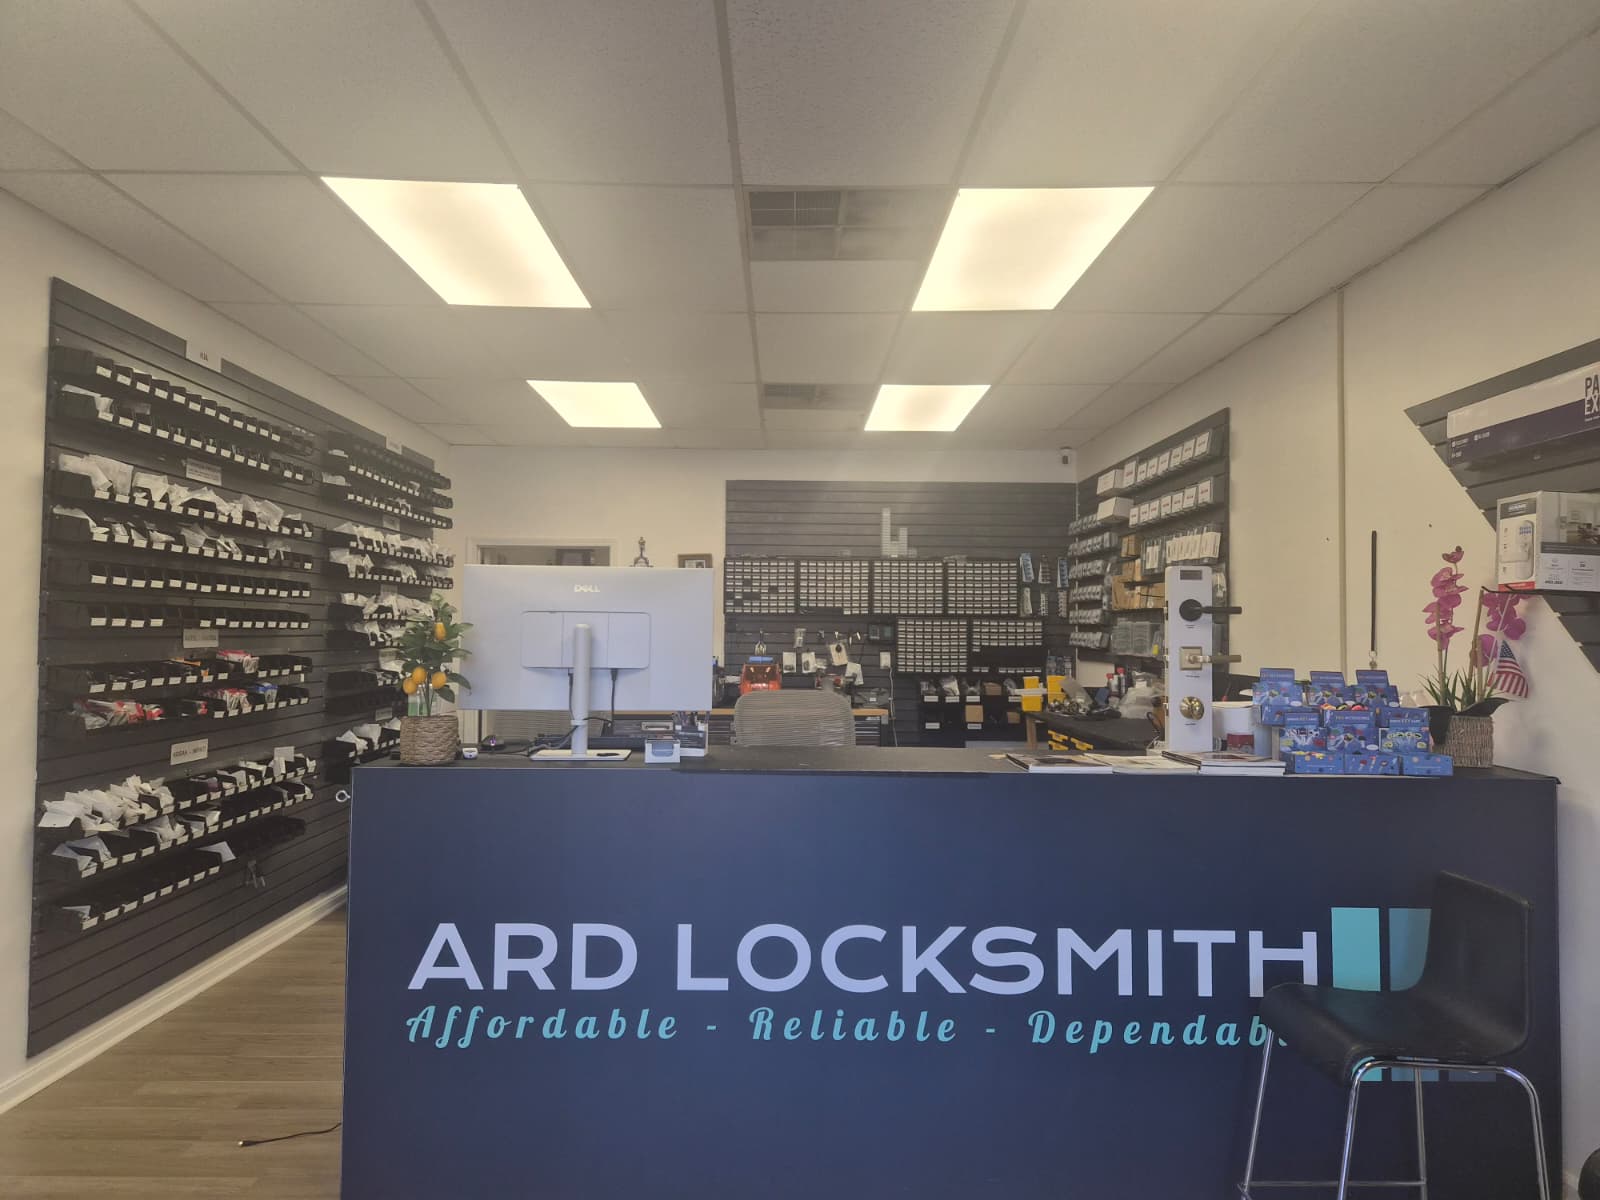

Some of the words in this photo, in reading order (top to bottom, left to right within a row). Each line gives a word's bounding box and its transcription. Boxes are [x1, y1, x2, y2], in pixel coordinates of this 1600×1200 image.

[574, 584, 600, 593] DELL
[408, 922, 638, 991] ARD
[676, 923, 1318, 998] LOCKSMITH
[405, 1005, 678, 1049] Affordable
[749, 1006, 957, 1042] Reliable
[1028, 1010, 1288, 1054] Dependab
